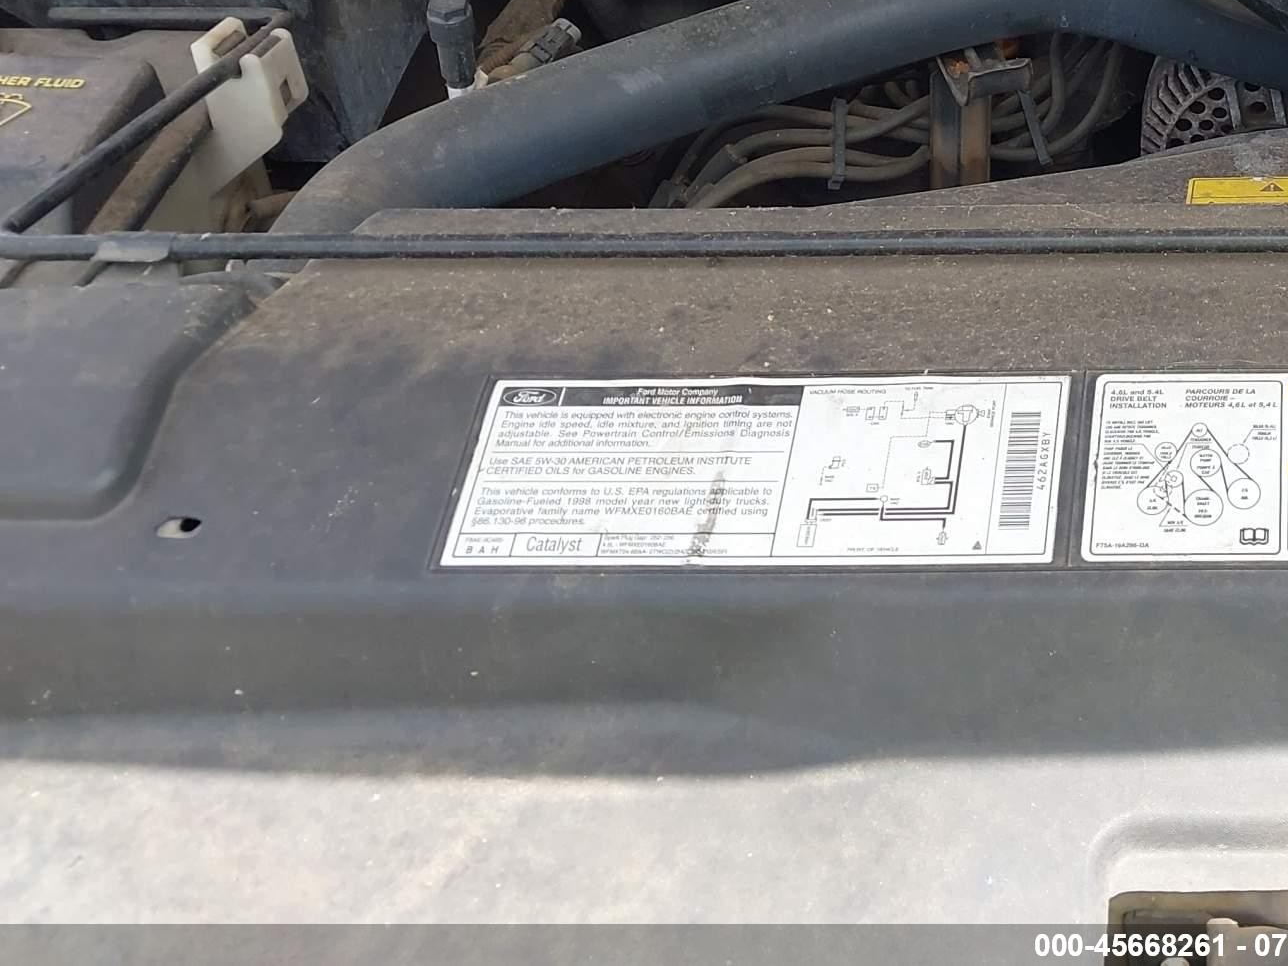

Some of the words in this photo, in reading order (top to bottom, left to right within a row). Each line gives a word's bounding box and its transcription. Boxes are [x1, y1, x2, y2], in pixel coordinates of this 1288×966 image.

[36, 76, 85, 88] FLUID
[513, 392, 546, 403] Ford
[637, 388, 656, 396] Ford
[682, 388, 718, 397] Company
[603, 397, 650, 405] IMPORTANT
[652, 397, 686, 405] VEHICLE
[687, 395, 742, 404] INFORMATION
[526, 411, 558, 419] vehicle
[571, 411, 614, 421] equipped
[685, 412, 716, 420] engine
[753, 412, 793, 420] systems.
[501, 421, 535, 429] Engine
[560, 421, 593, 429] speed,
[619, 421, 657, 429] mixture,
[684, 421, 719, 429] ignition
[723, 421, 752, 429] timing
[583, 430, 636, 438] Powertrain
[642, 429, 735, 438] Control/Emissions
[740, 430, 790, 439] Diagnosis
[490, 457, 507, 465] Use
[510, 457, 533, 465] SAE
[536, 457, 566, 465] 5W-30
[570, 457, 625, 465] AMERICAN
[628, 457, 694, 465] PETROLEUM
[697, 456, 752, 465] INSTITUTE
[486, 467, 542, 475] CERTIFIED
[545, 467, 569, 475] OILS
[588, 467, 642, 475] GASOLINE
[645, 467, 696, 475] ENGINES.
[652, 488, 706, 498] regulations
[710, 488, 760, 498] applicable
[477, 498, 561, 506] Gasoline-Fueled
[632, 499, 654, 507] year
[684, 498, 731, 507] light-duty
[474, 507, 534, 518] Evaporative
[538, 507, 568, 518] family
[605, 507, 693, 515] WFMXE0160BAE
[697, 507, 739, 515] certified
[741, 508, 768, 517] using
[529, 517, 585, 526] procedures.
[479, 546, 485, 554] A
[491, 546, 499, 554] H
[526, 537, 582, 554] Catalyst
